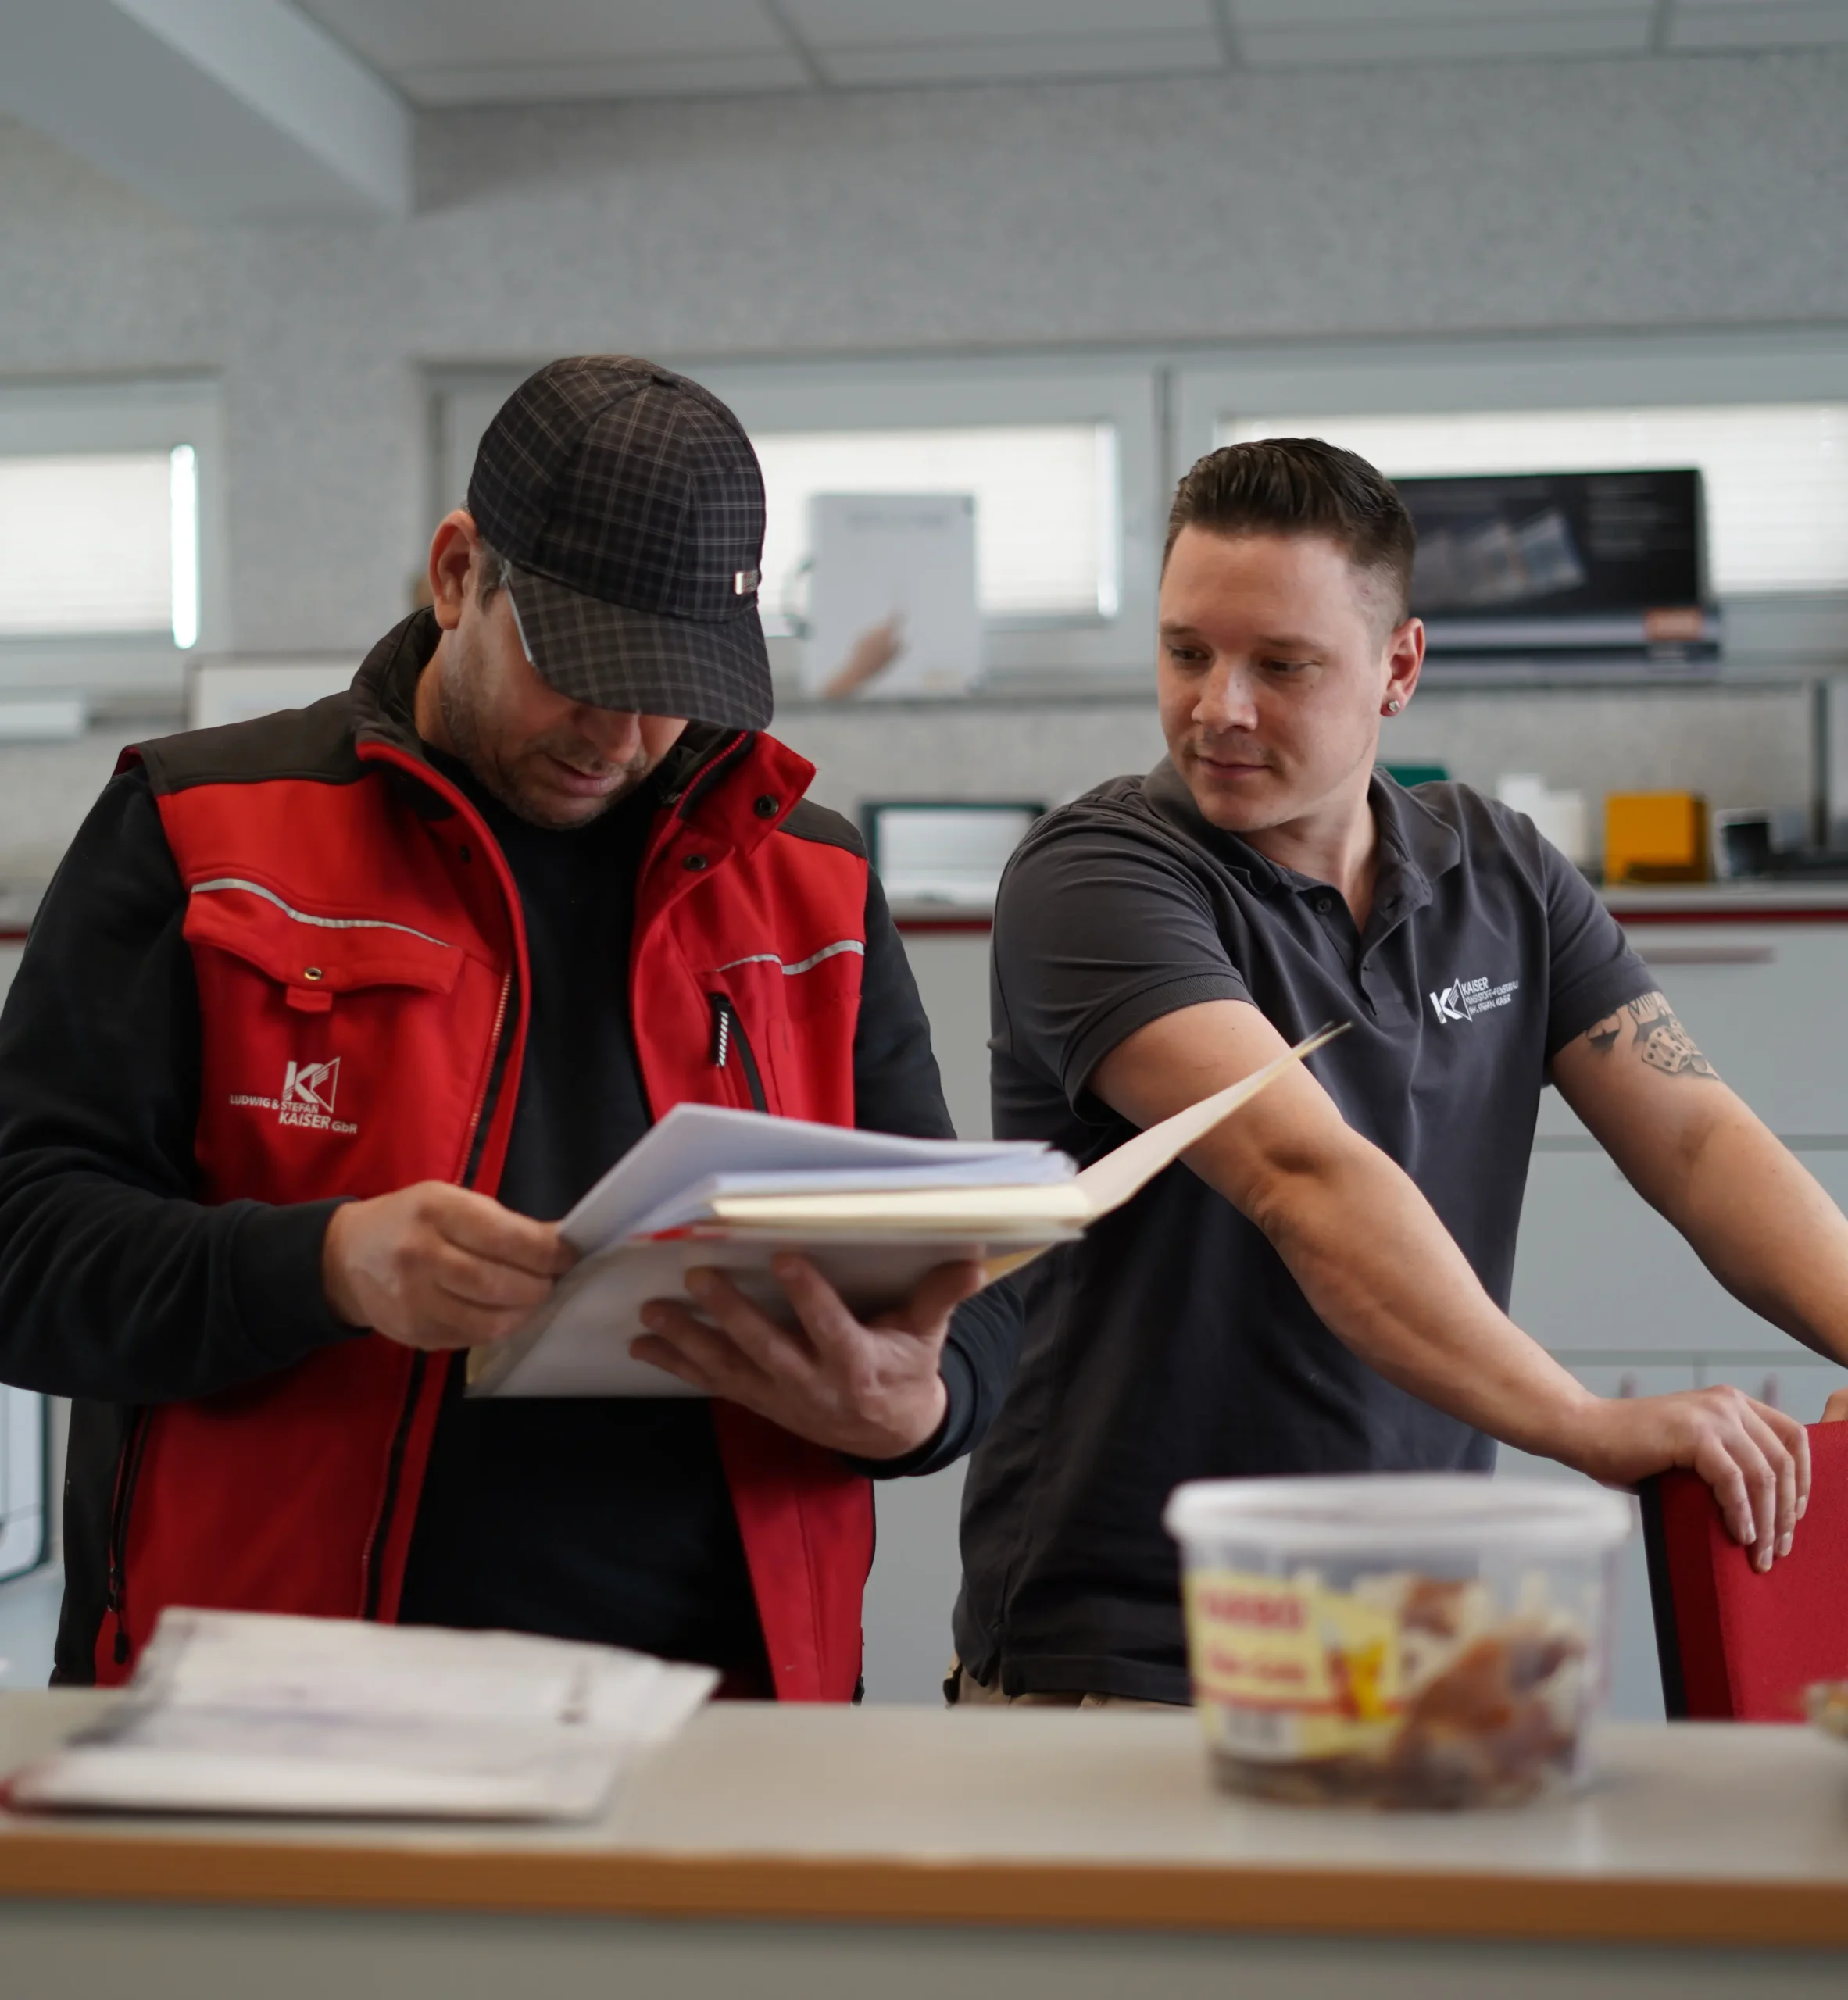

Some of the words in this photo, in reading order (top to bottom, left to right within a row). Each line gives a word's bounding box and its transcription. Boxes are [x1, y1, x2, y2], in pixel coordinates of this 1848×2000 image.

[1461, 977, 1489, 995] KAISER
[229, 1094, 270, 1109] LUDWIG
[271, 1098, 280, 1109] &
[281, 1101, 320, 1113] STEFAN
[278, 1111, 331, 1130] KAISER
[331, 1120, 358, 1134] GbR
